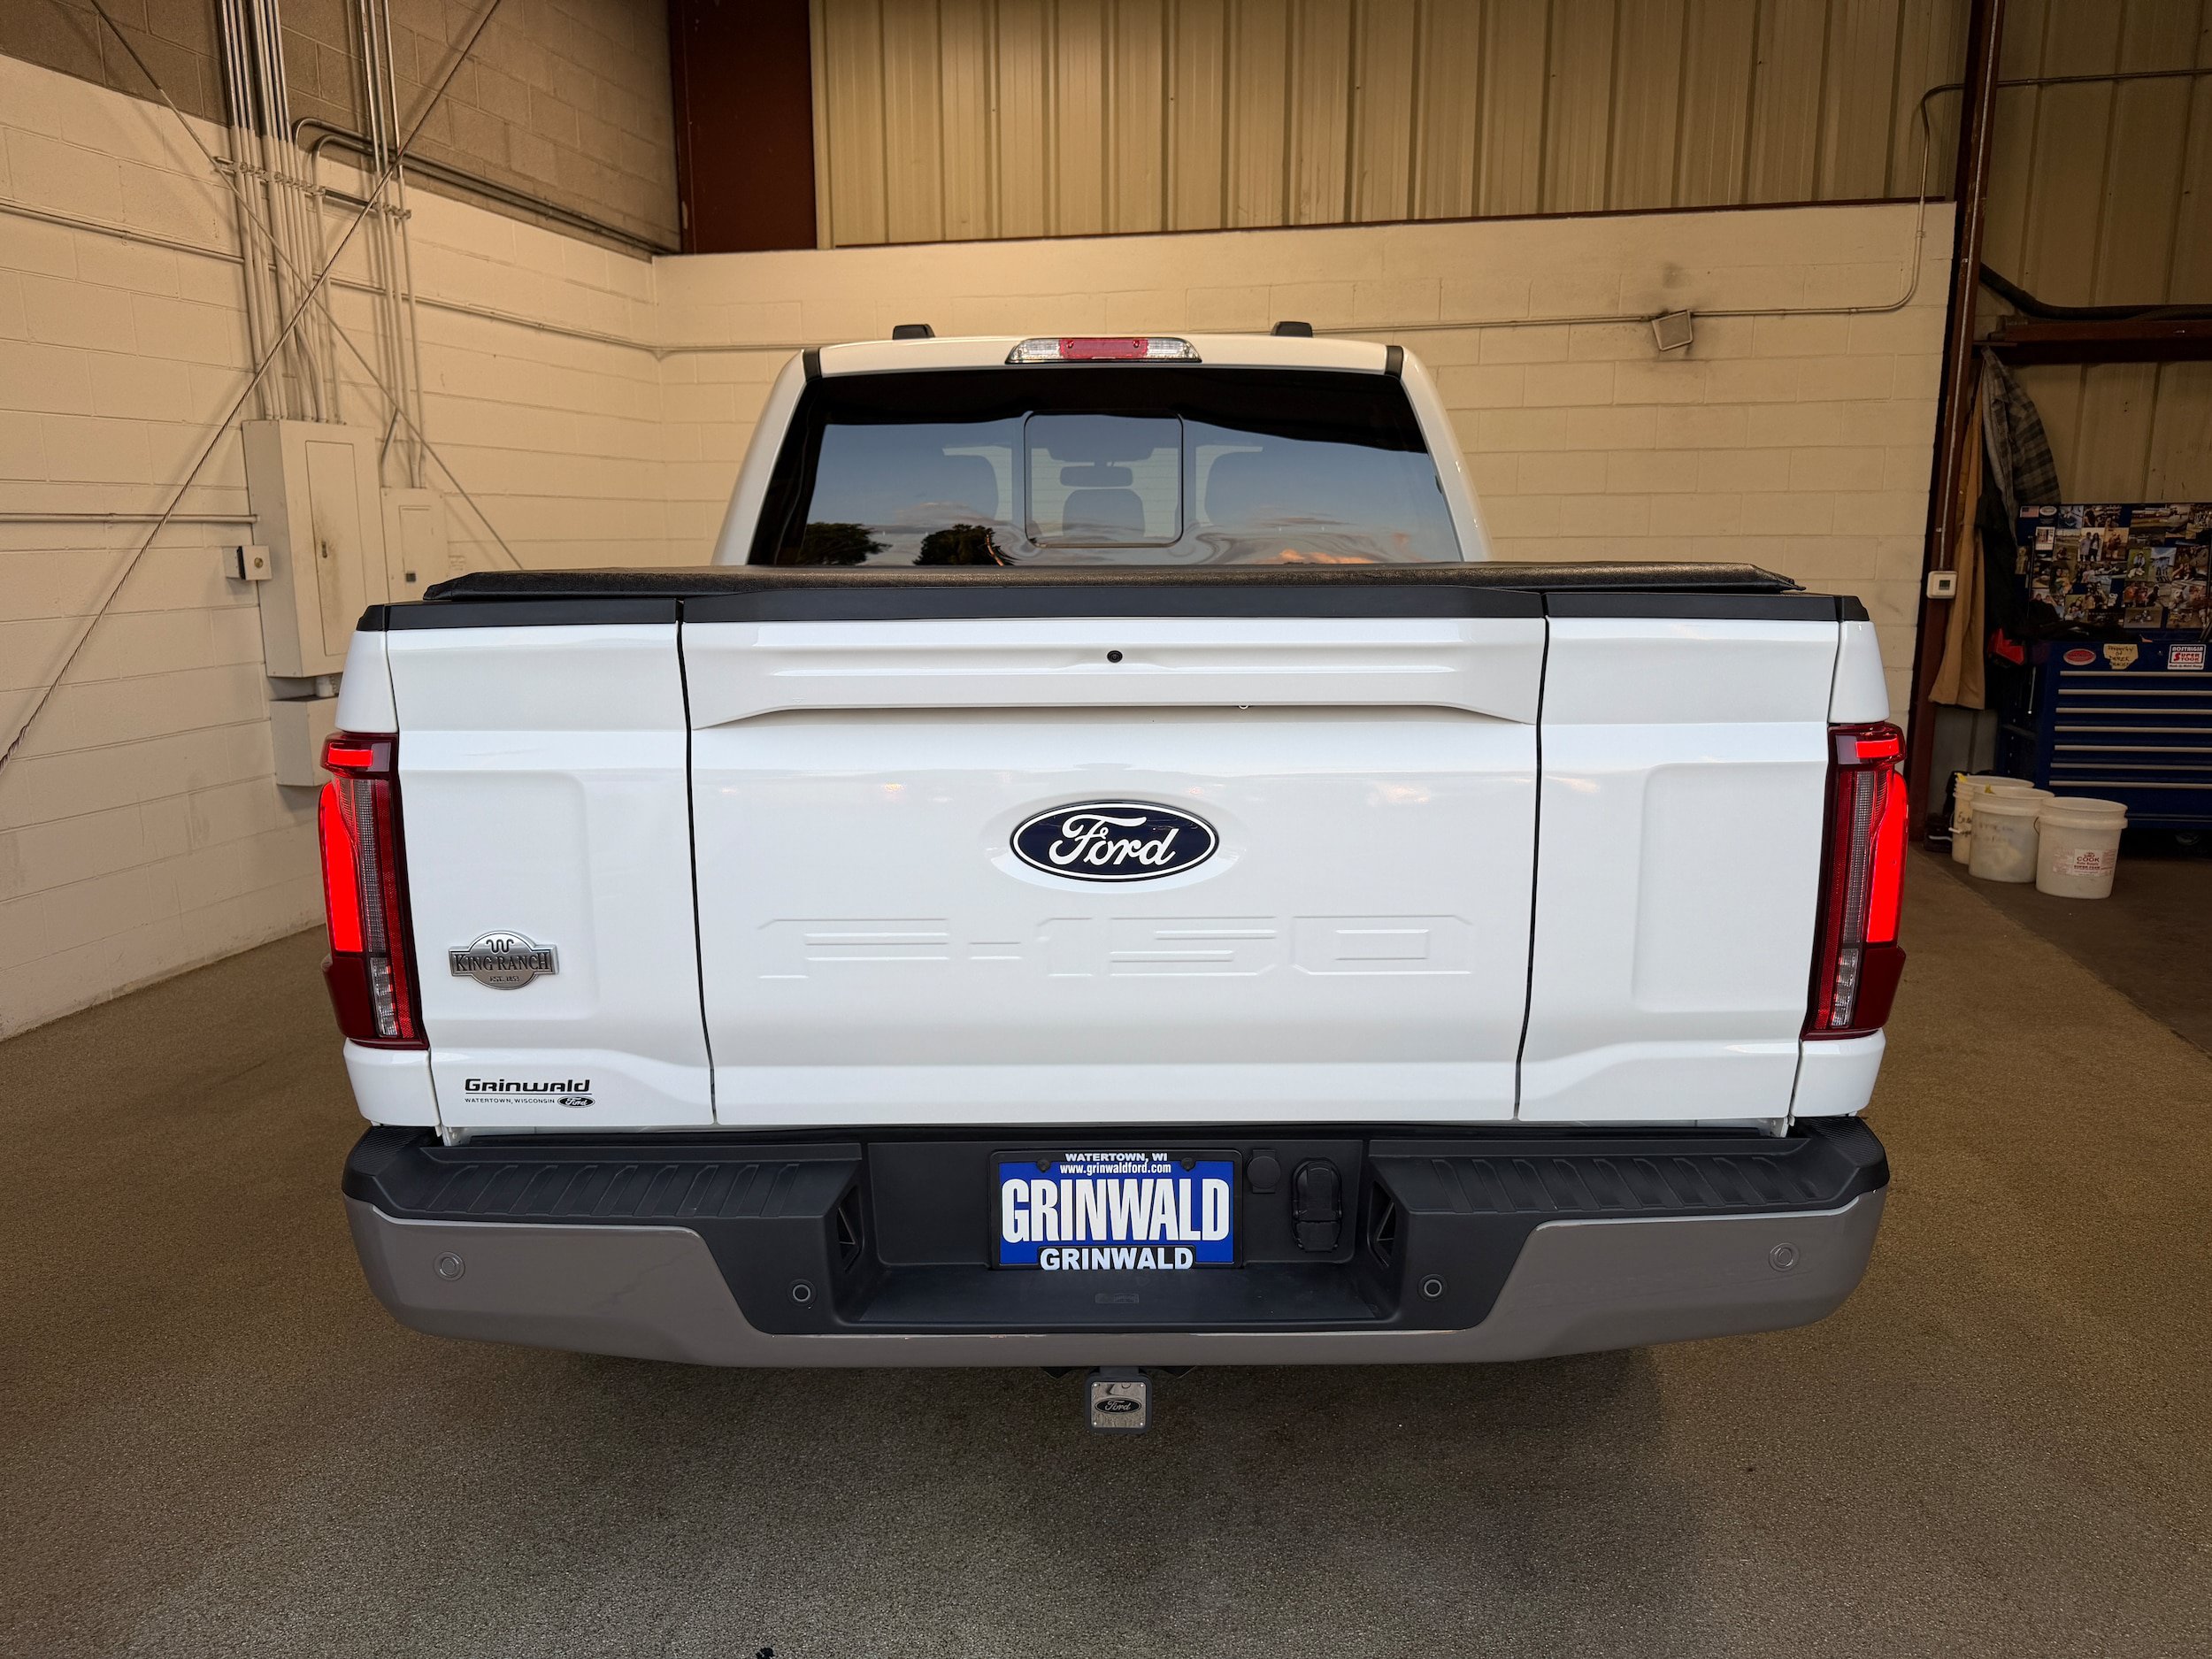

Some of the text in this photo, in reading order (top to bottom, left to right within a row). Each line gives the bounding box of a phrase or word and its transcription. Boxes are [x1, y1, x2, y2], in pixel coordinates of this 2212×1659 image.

[1048, 812, 1177, 868] Ford
[454, 951, 550, 972] KING RANCH
[1065, 1153, 1168, 1163] WATERTOWN, WI
[1060, 1163, 1171, 1176] www.grinwaldford.com
[1002, 1178, 1230, 1243] GRINWALD
[1040, 1248, 1194, 1271] GRINWALD
[1104, 1400, 1132, 1411] Ford
